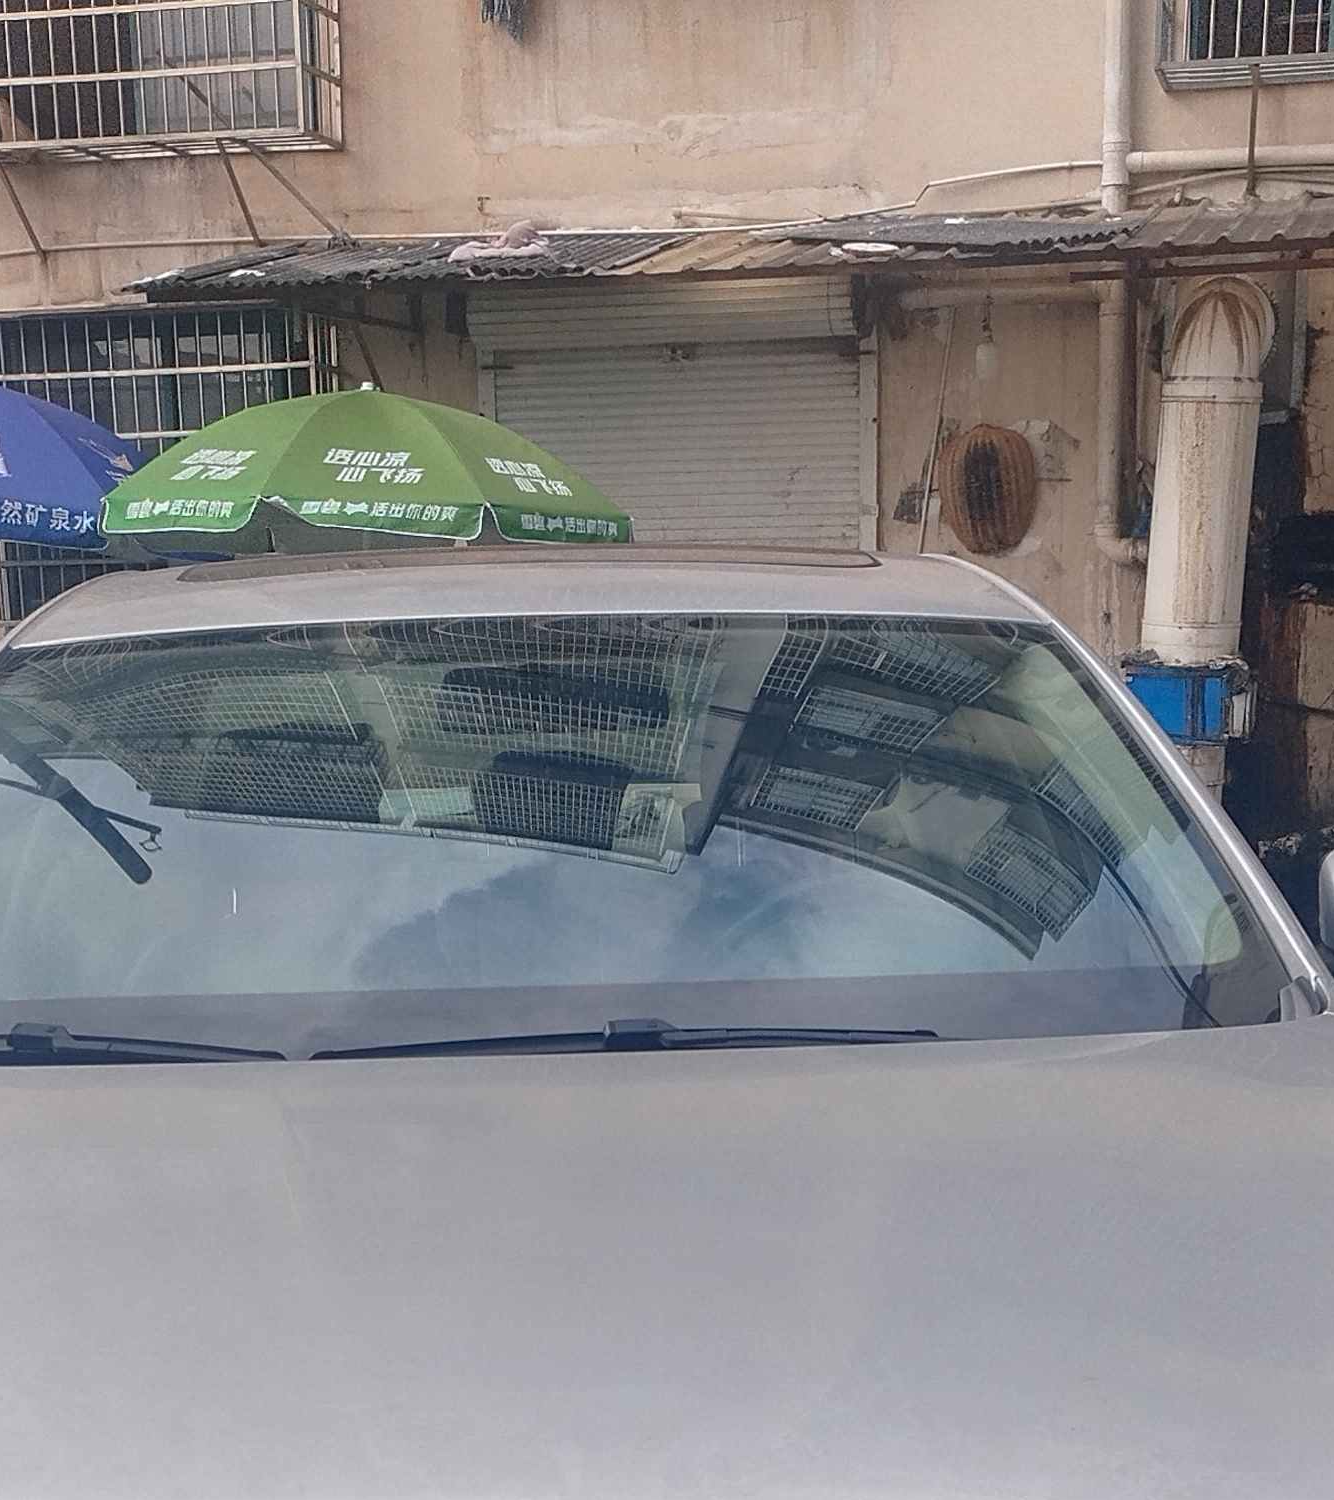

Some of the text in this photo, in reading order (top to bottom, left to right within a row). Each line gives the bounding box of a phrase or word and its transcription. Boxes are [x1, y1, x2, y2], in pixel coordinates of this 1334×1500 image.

[323, 448, 411, 467] 透心凉
[335, 467, 425, 484] 心飞扬
[485, 457, 547, 479] 透心凉
[513, 477, 573, 497] 心飞扬
[169, 498, 234, 519] 活出你的爽
[299, 498, 459, 522] 雪碧 活出你的爽
